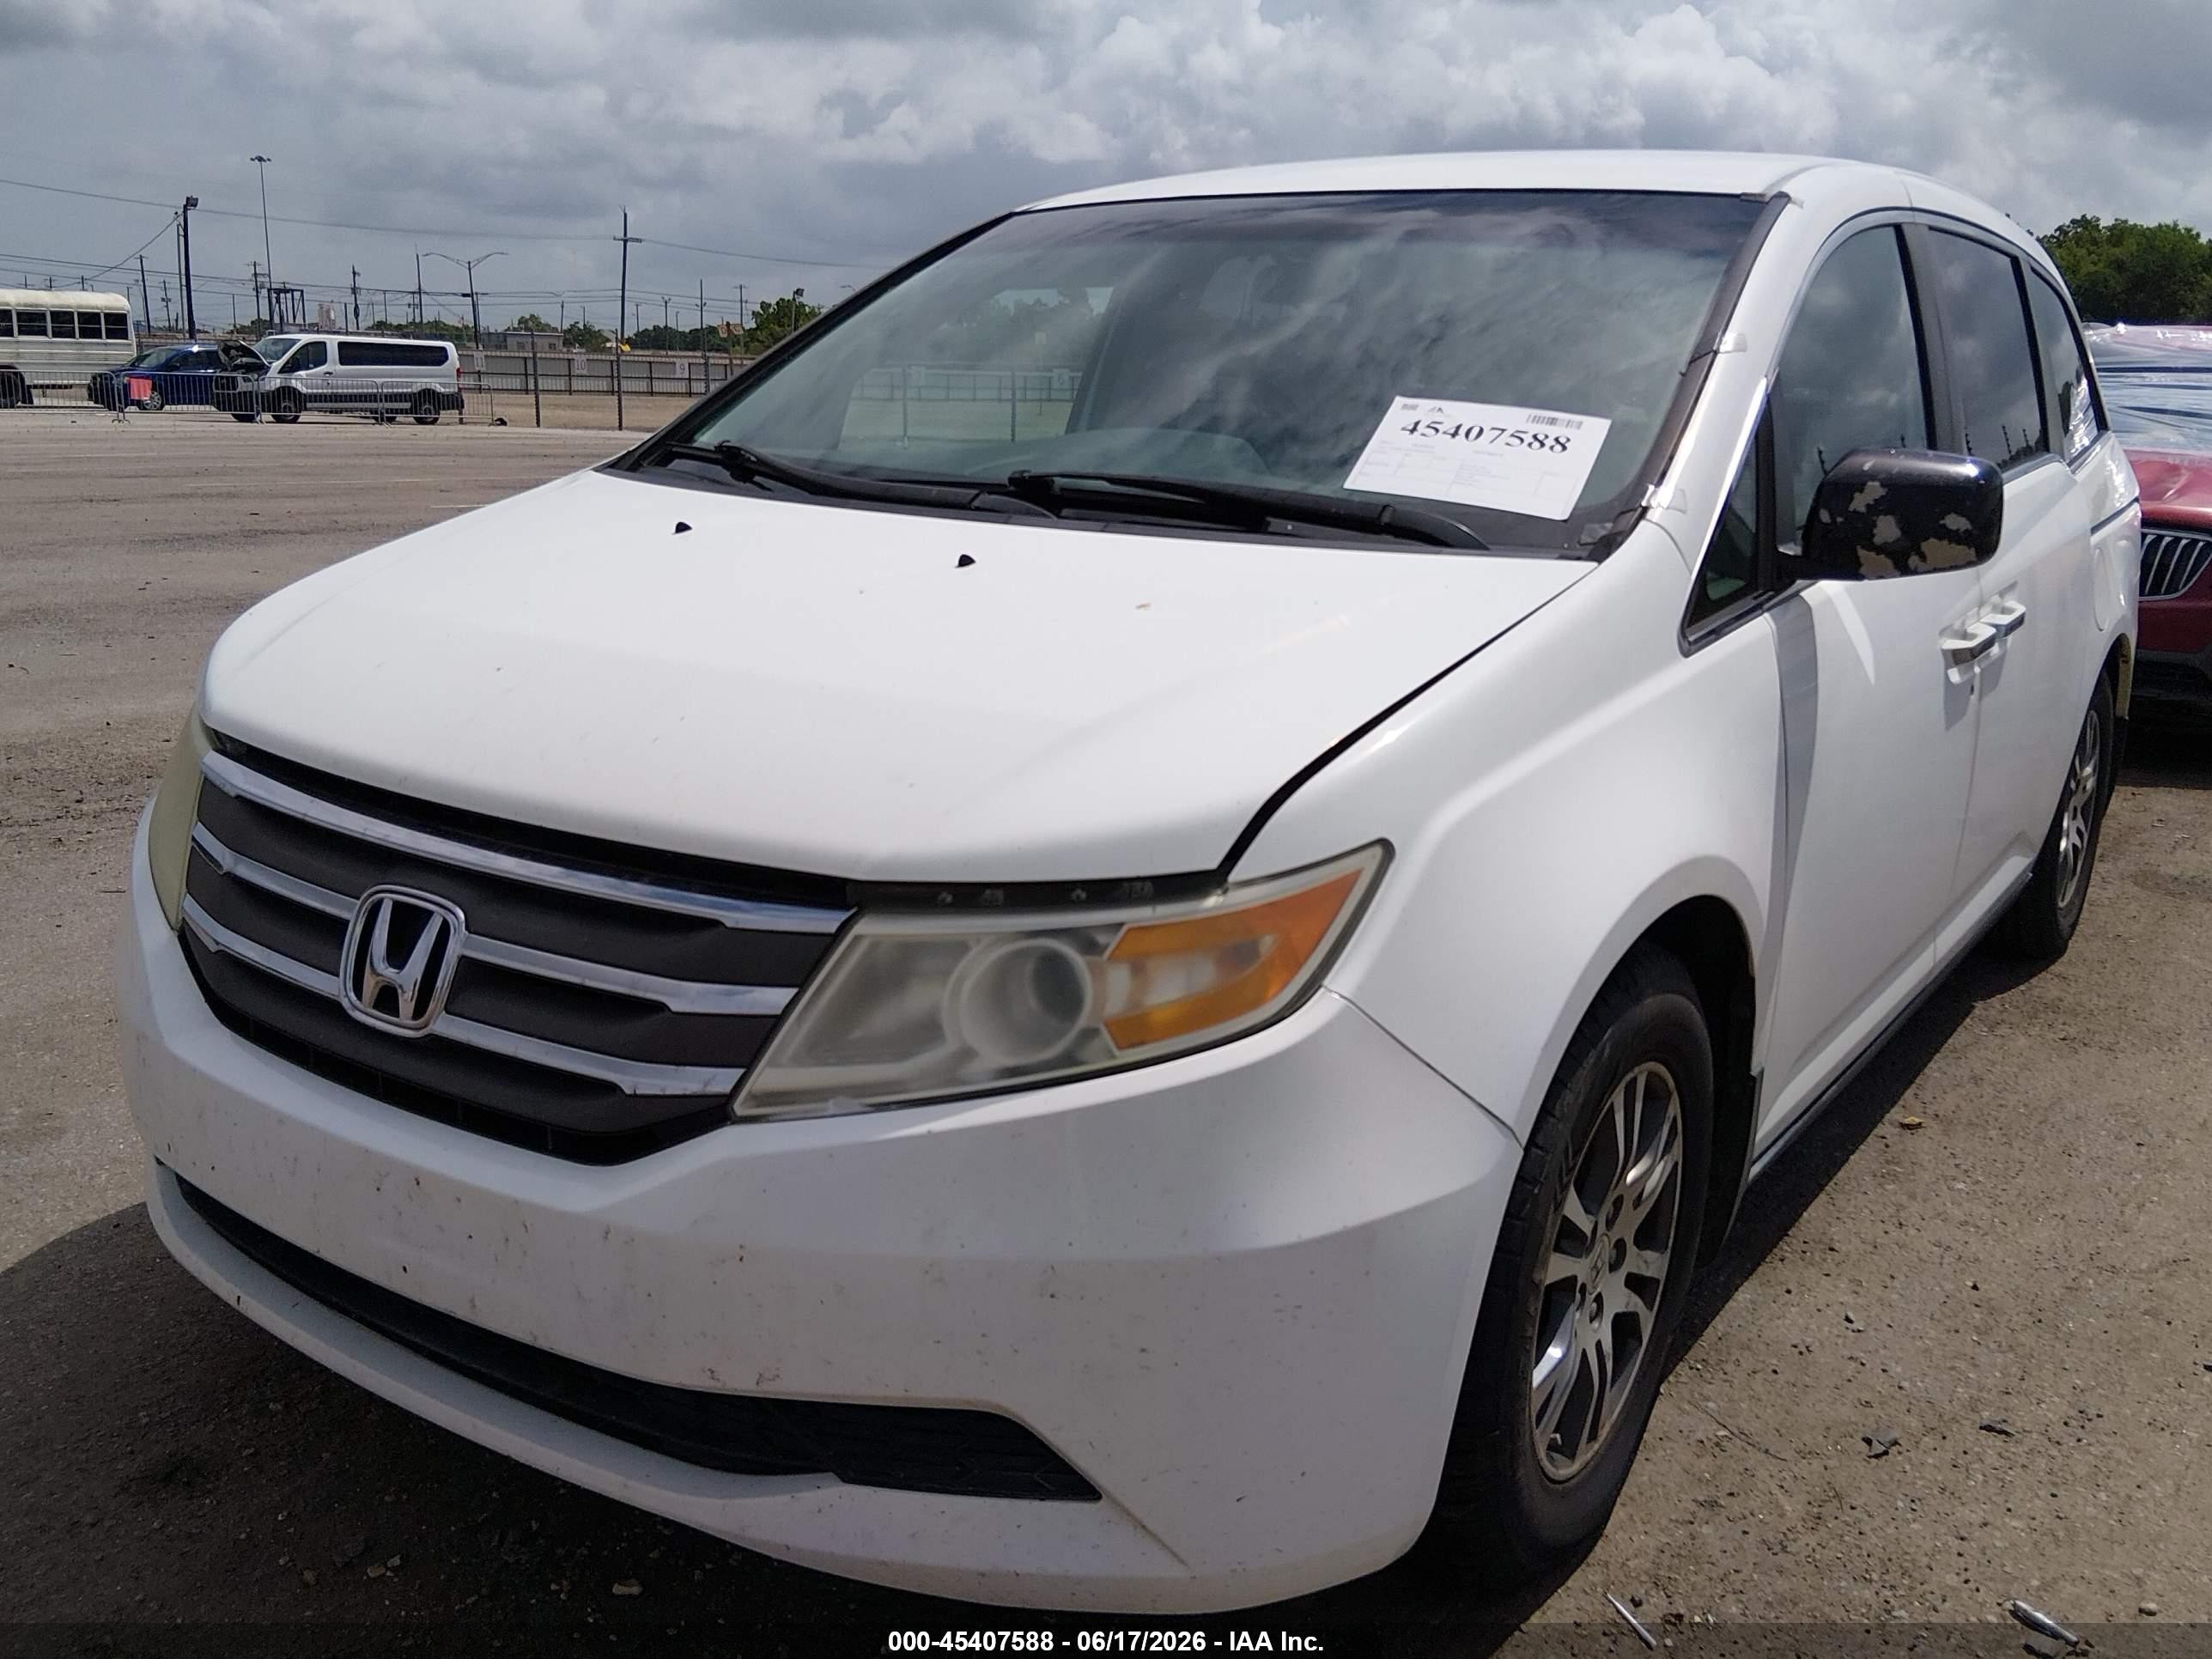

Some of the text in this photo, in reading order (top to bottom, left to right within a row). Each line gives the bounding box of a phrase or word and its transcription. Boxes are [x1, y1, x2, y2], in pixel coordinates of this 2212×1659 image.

[475, 356, 485, 368] 11
[576, 359, 586, 371] 10
[679, 363, 686, 375] 9
[1401, 419, 1571, 453] 45407588
